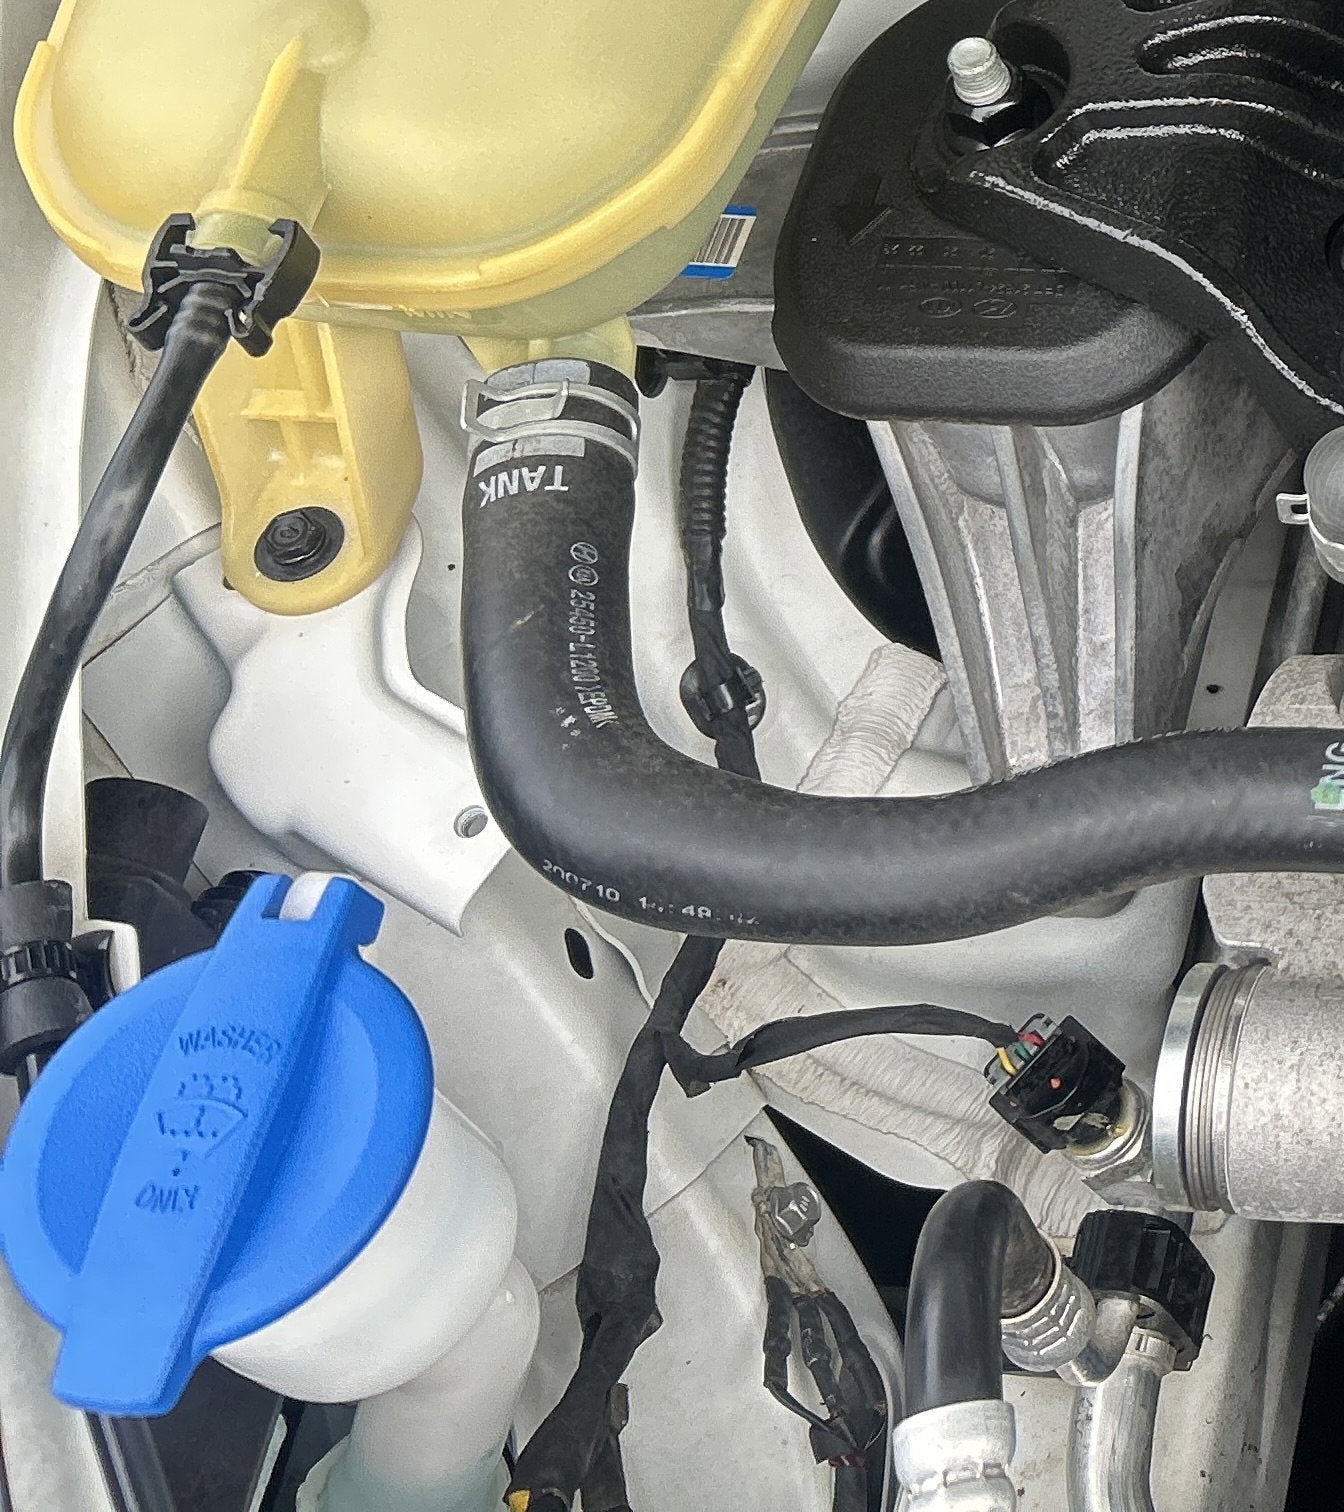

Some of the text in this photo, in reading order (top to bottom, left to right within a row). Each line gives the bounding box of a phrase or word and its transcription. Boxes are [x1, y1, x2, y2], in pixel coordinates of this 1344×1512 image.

[478, 463, 569, 508] TANK
[178, 1021, 285, 1065] WASHER
[134, 1184, 200, 1214] ONLY
